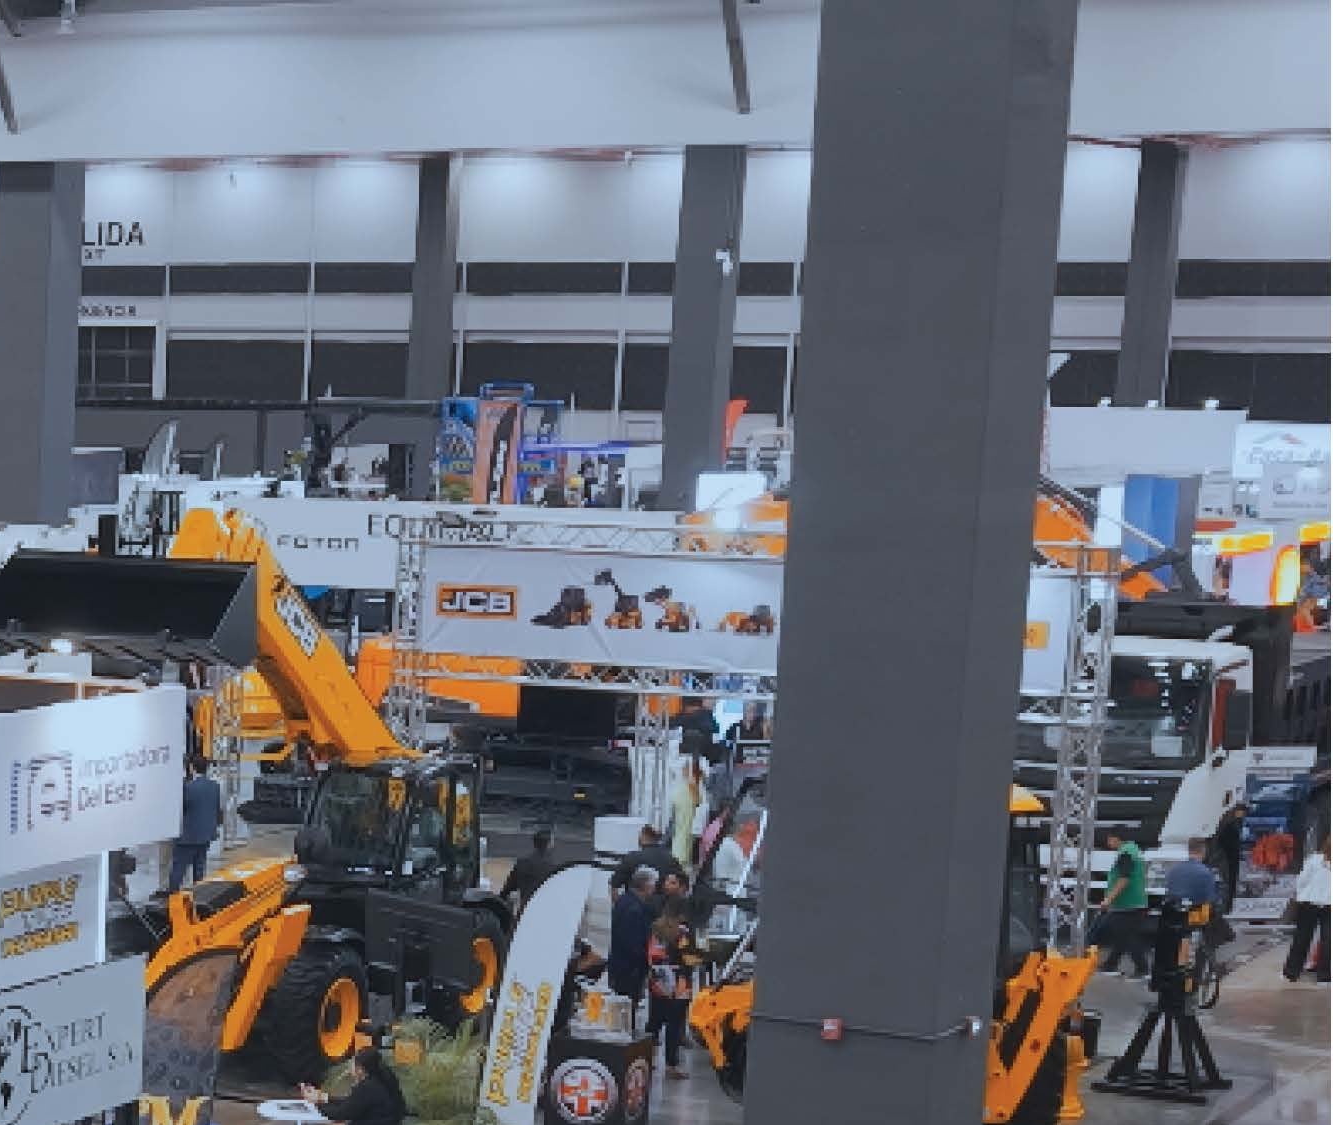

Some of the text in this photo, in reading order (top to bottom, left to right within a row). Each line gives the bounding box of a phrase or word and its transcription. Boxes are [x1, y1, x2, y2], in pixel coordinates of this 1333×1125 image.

[277, 534, 359, 551] FOTON
[442, 591, 511, 613] JCB
[78, 746, 170, 777] Importadora
[78, 783, 136, 811] Del Este
